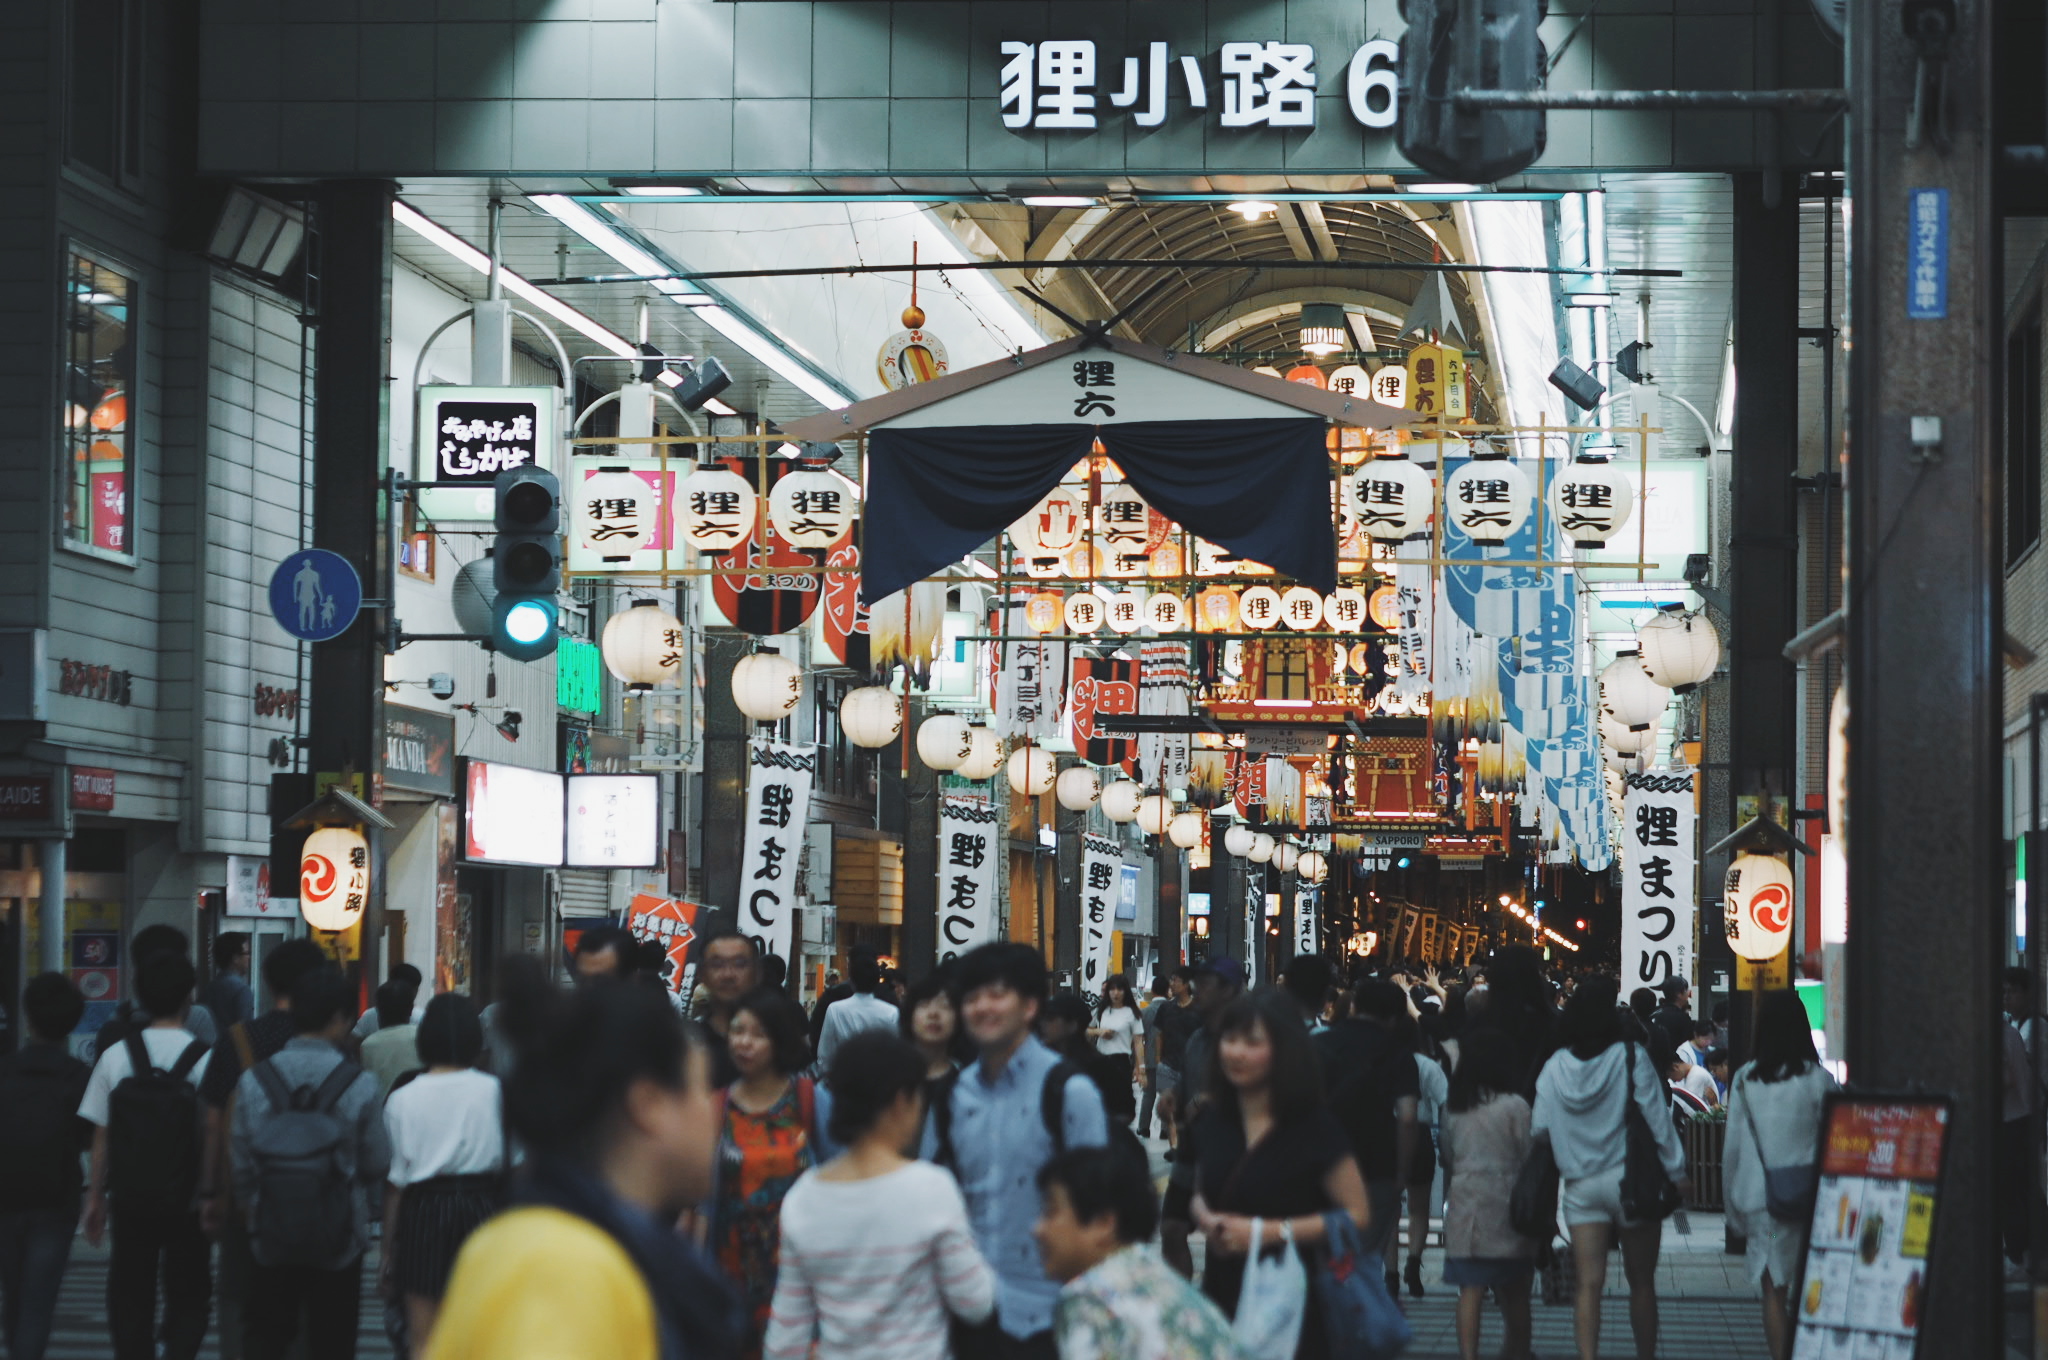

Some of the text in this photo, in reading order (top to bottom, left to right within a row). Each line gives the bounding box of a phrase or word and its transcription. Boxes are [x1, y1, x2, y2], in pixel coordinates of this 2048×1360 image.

[1000, 39, 1399, 129] 狸小路 6
[1072, 359, 1116, 418] 狸六
[442, 415, 532, 442] おみやげの店
[588, 498, 640, 541] 狸六
[690, 490, 741, 538] 狸六
[789, 490, 841, 538] 狸六
[1102, 501, 1147, 543] 狸六
[1356, 479, 1406, 528] 狸六
[1459, 478, 1512, 528] 狸六
[1561, 482, 1613, 532] 狸六
[1072, 602, 1094, 624] 狸
[1114, 602, 1135, 621] 狸
[1155, 602, 1176, 623] 狸
[1247, 597, 1270, 620] 狸
[1290, 599, 1313, 621] 狸
[1336, 598, 1358, 621] 狸
[1375, 836, 1420, 846] SAPPORO
[1635, 803, 1679, 991] 狸まつり
